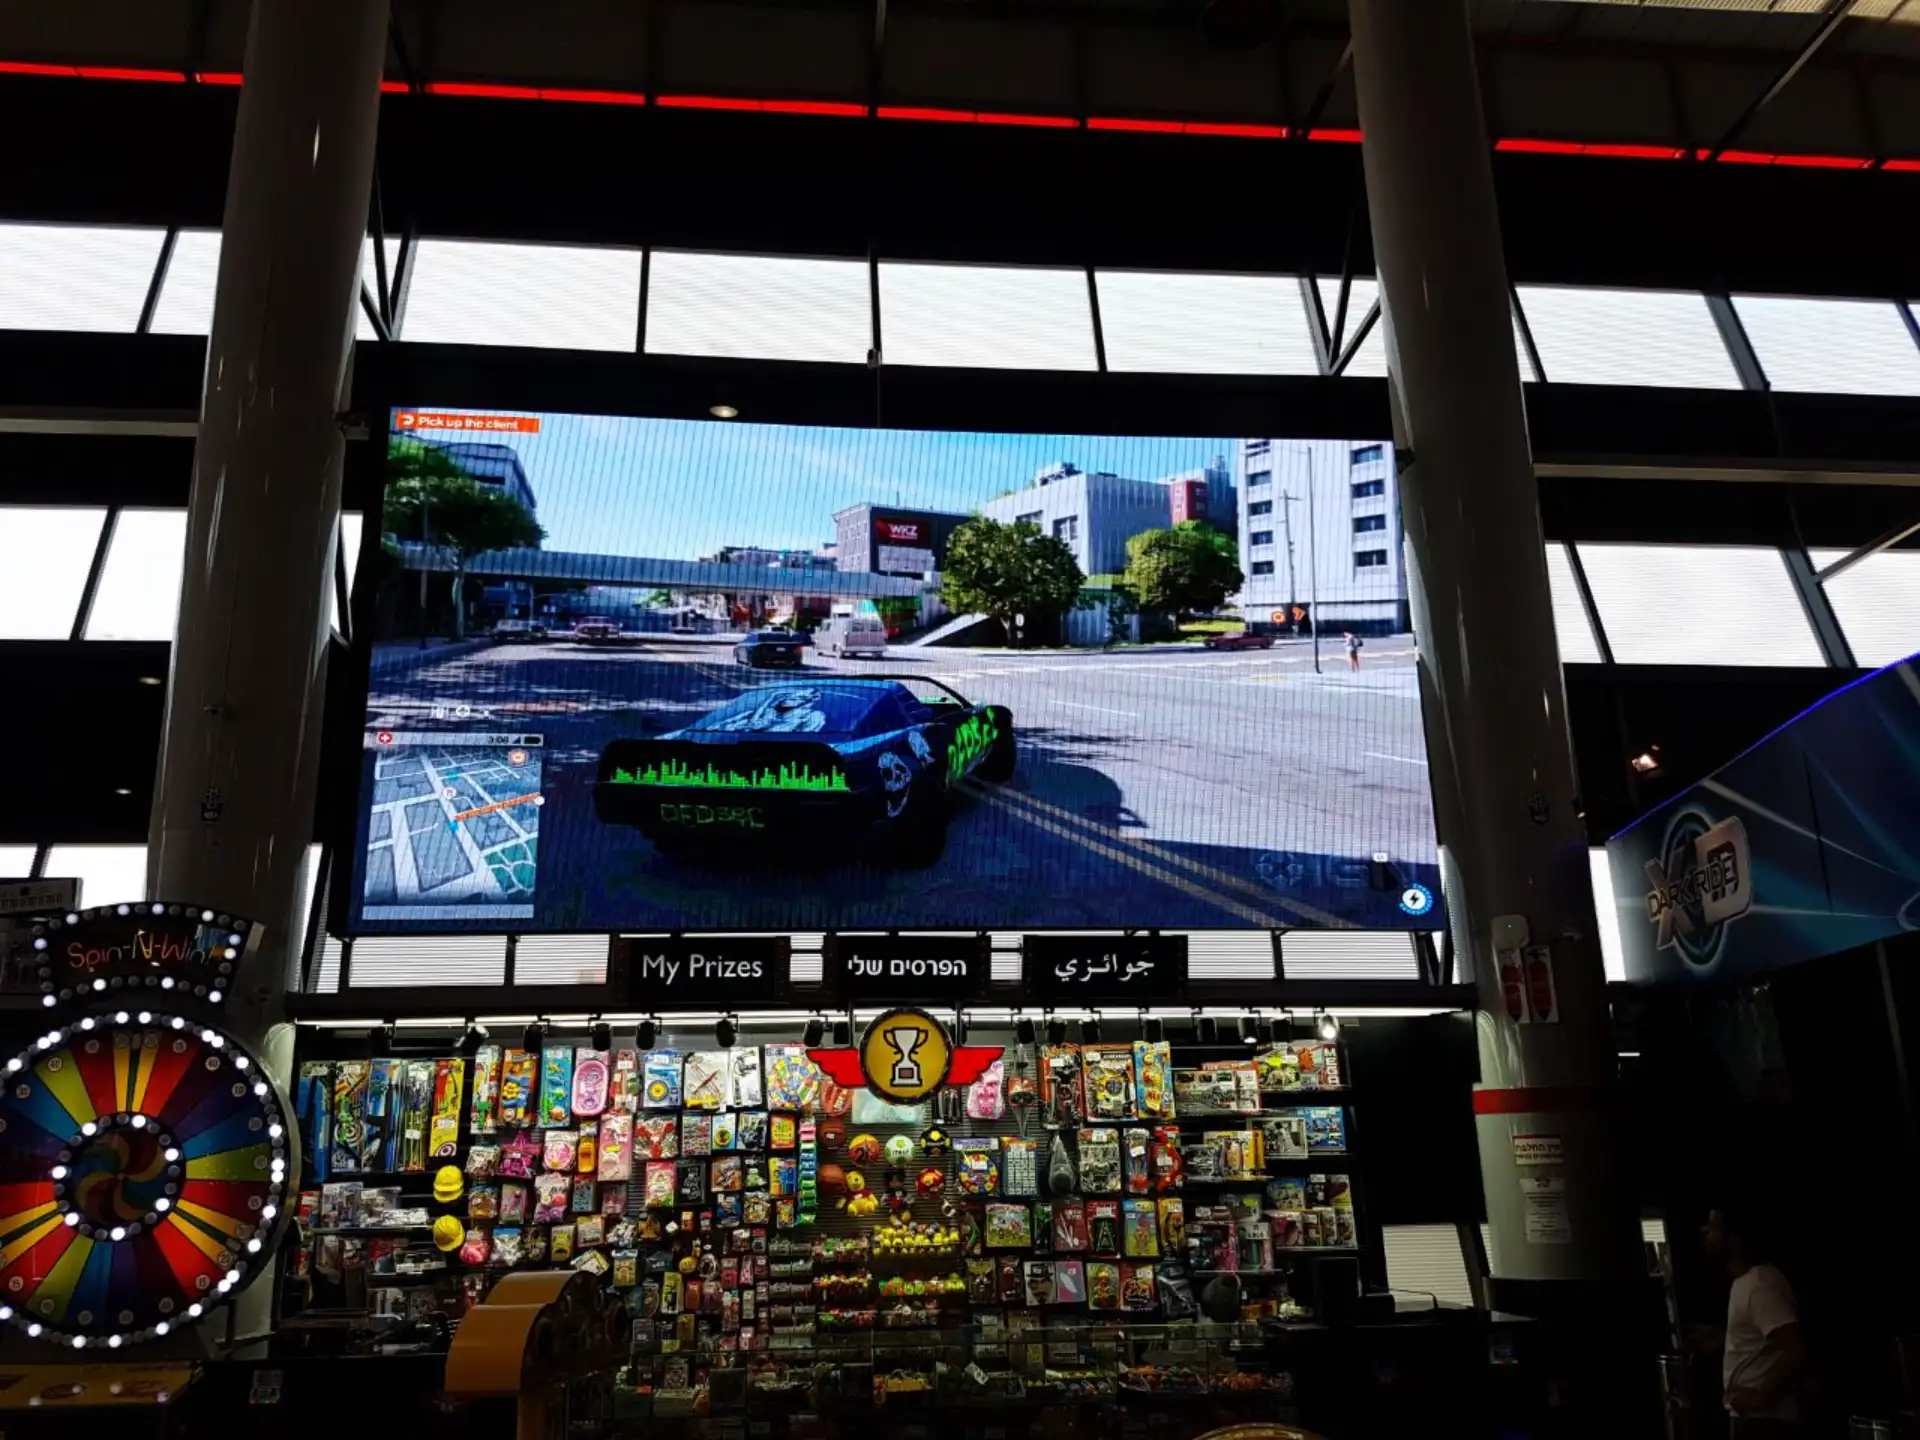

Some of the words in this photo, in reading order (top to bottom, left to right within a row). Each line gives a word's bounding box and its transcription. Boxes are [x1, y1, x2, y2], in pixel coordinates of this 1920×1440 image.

[418, 415, 443, 427] Pick
[446, 418, 462, 429] up
[465, 416, 484, 428] the
[485, 418, 518, 430] client
[643, 954, 680, 985] My
[689, 953, 763, 978] Prizes
[848, 954, 883, 976] שלי
[890, 959, 967, 976] הפרסים
